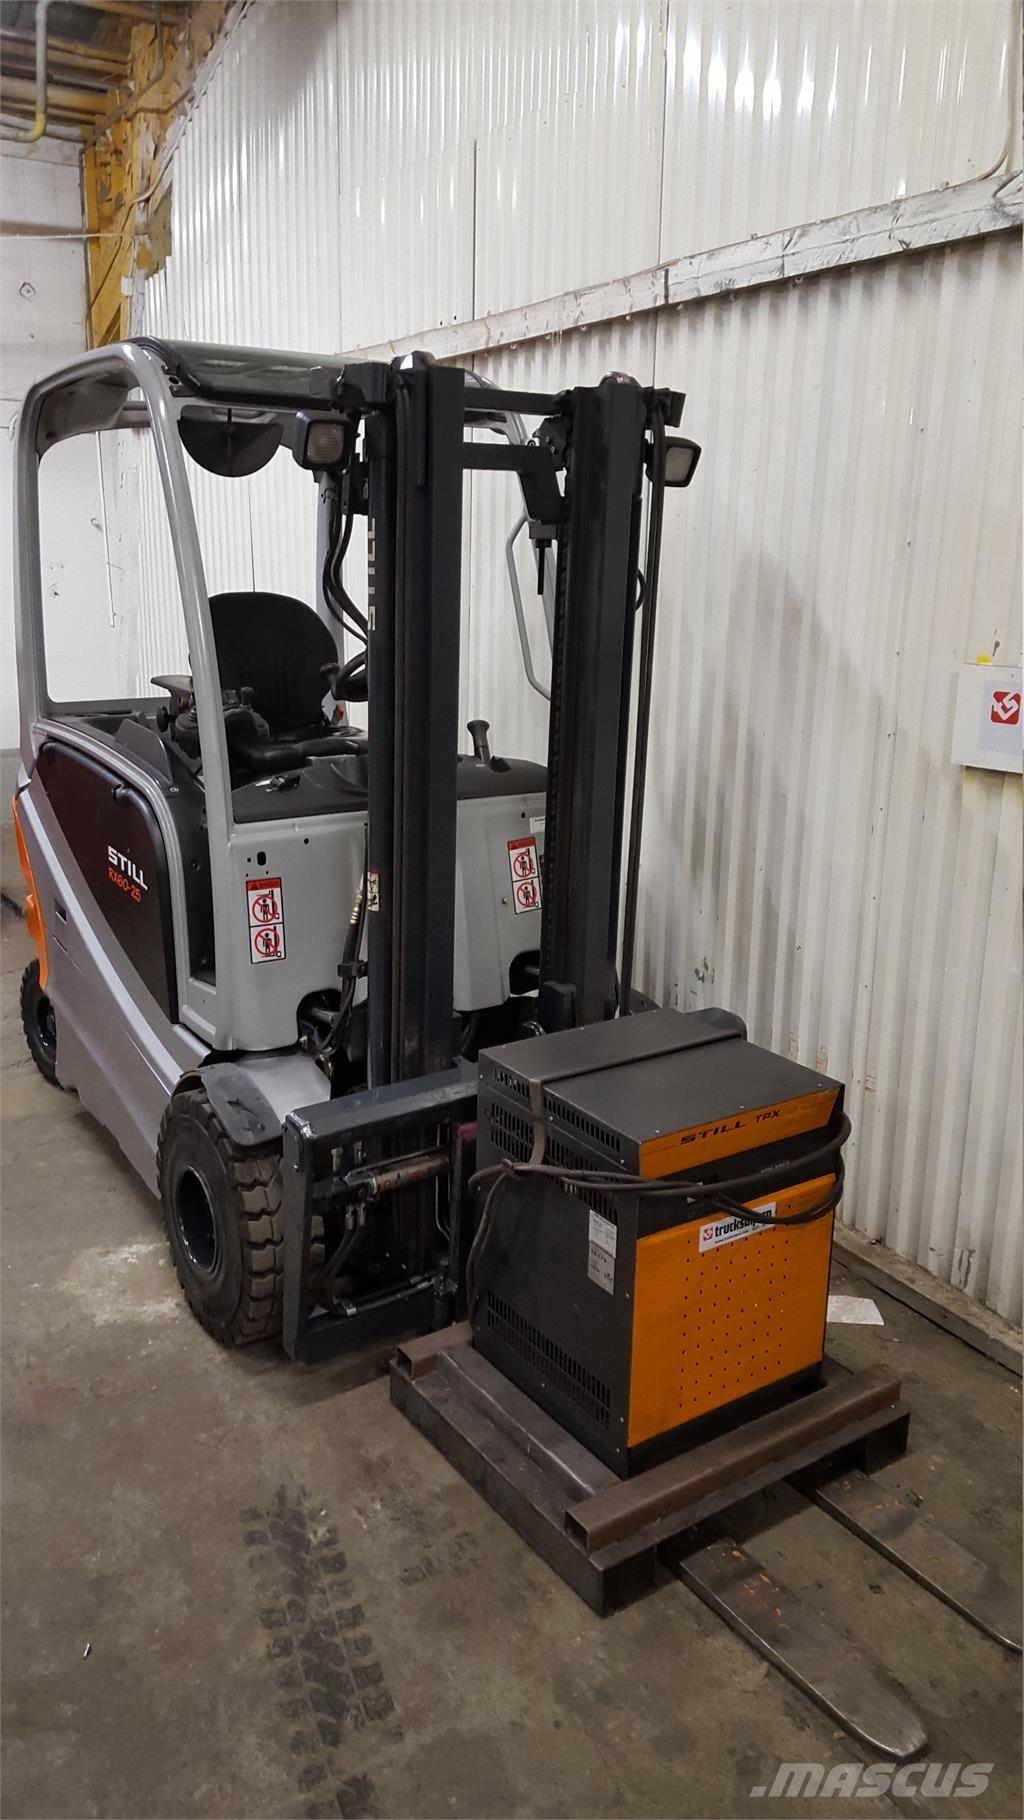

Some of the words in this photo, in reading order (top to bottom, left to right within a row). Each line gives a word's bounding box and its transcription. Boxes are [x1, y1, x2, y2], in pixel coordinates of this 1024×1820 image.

[108, 845, 149, 890] STILL
[108, 867, 142, 902] RX60-25
[679, 1120, 747, 1146] STILL
[755, 1109, 782, 1123] TPX
